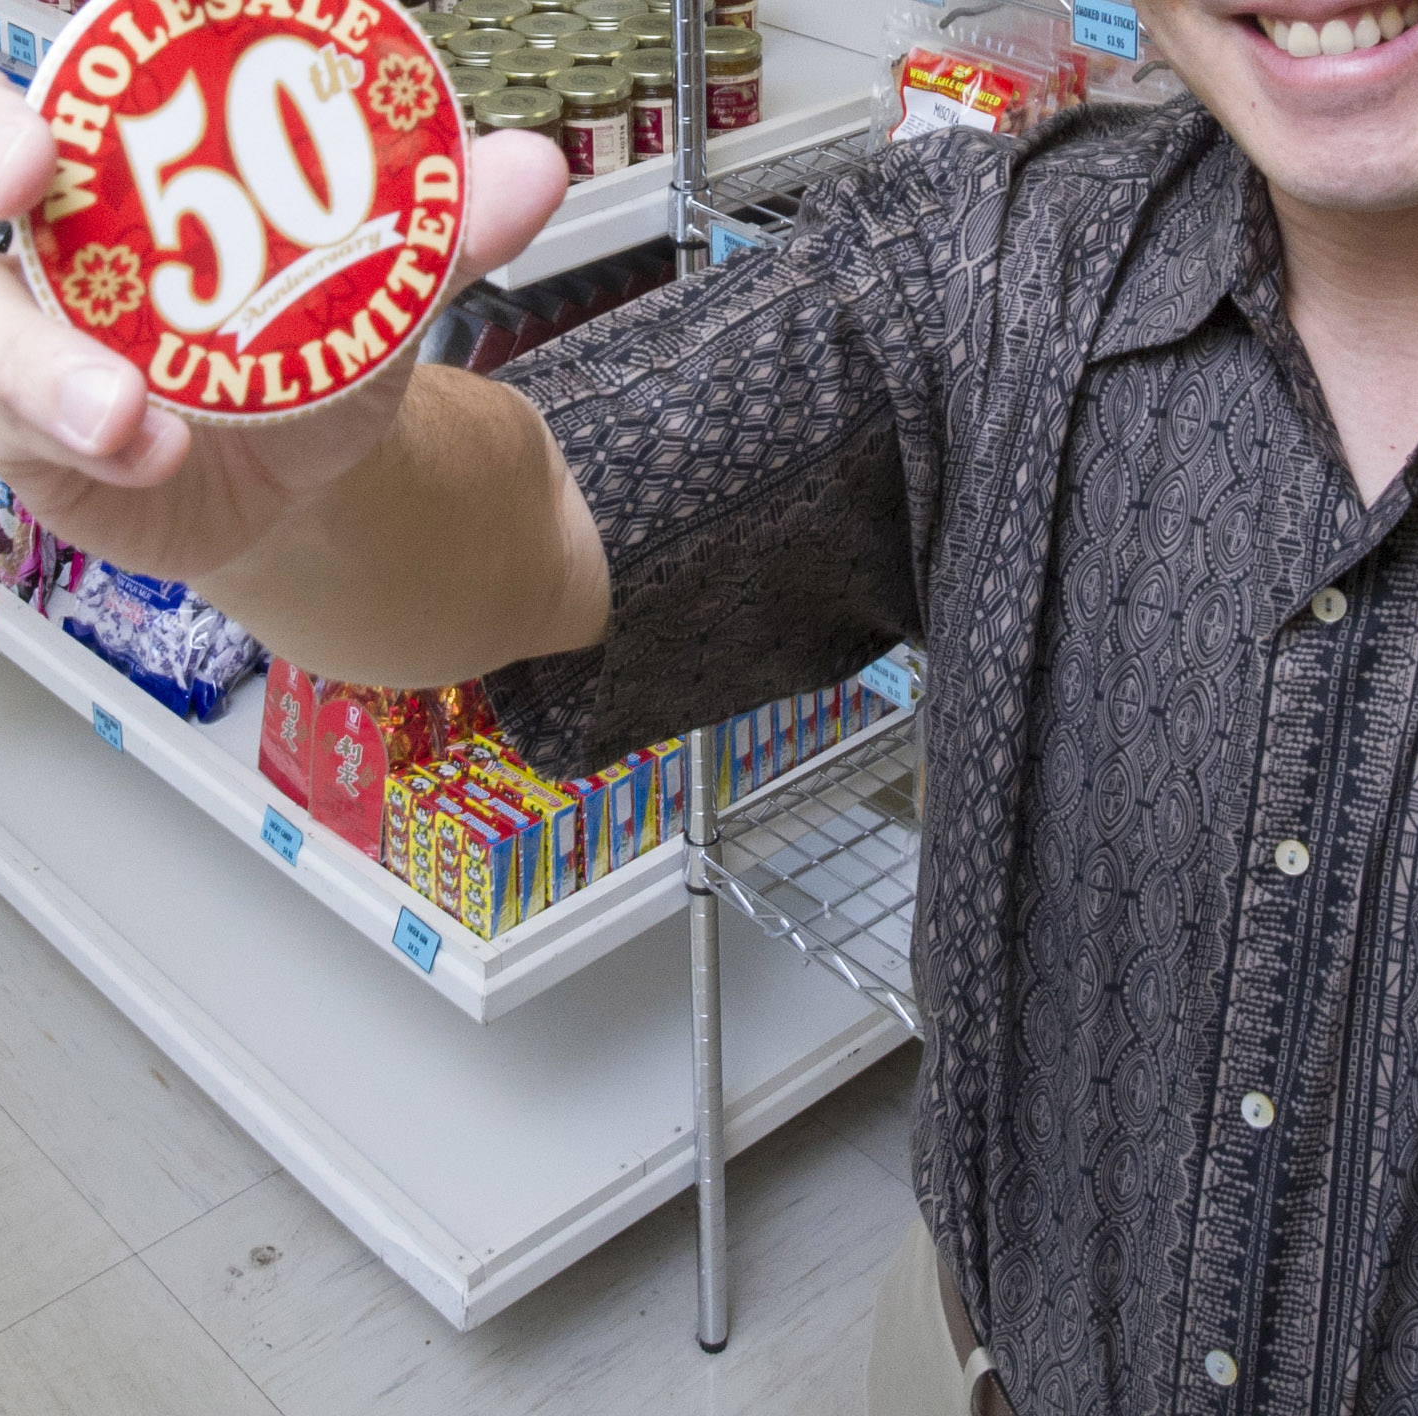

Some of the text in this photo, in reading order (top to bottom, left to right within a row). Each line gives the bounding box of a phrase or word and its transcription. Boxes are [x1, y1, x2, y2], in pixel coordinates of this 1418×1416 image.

[1075, 4, 1135, 32] SMOKED IKA STICKS
[1107, 32, 1125, 49] $3.95
[909, 67, 955, 89] WHOLESALE
[934, 102, 960, 125] MISO IKA
[149, 153, 460, 407] UNLIMITED
[241, 226, 384, 332] Anniversary
[419, 932, 429, 946] GUM
